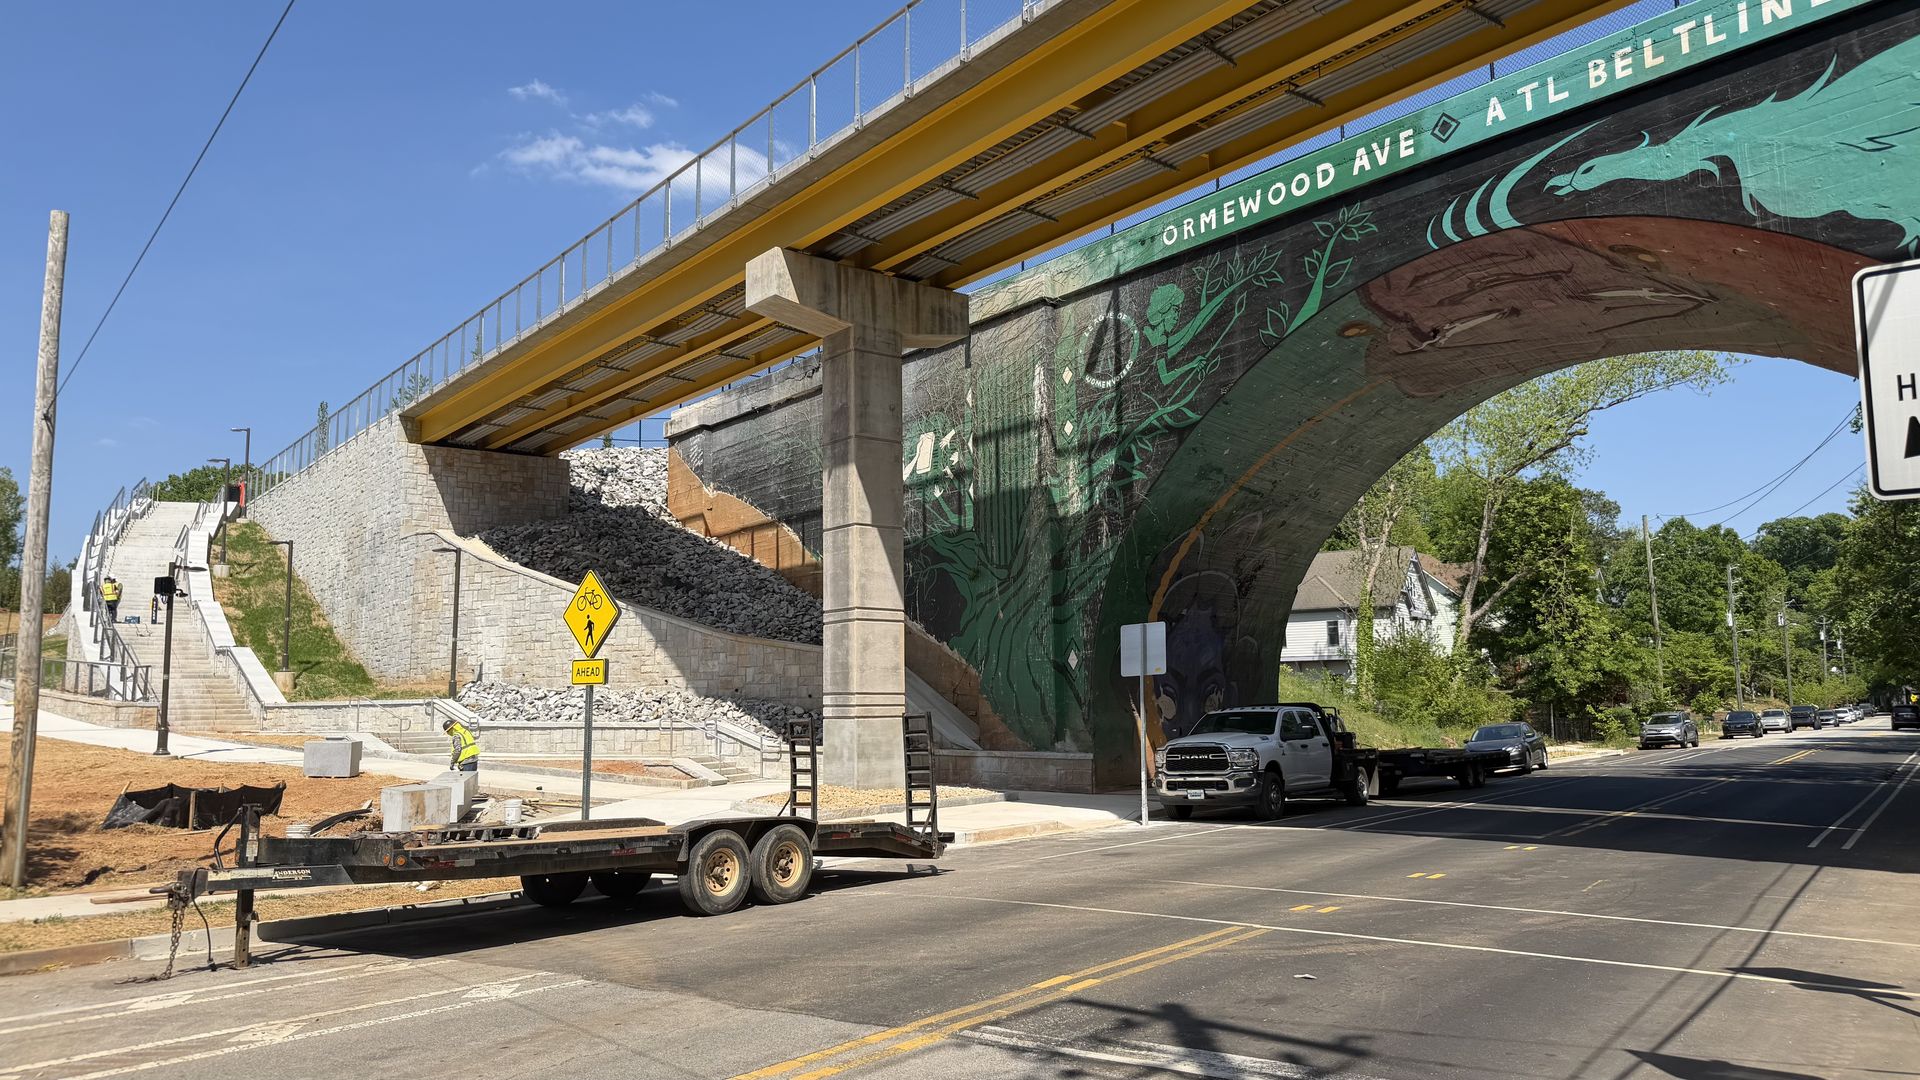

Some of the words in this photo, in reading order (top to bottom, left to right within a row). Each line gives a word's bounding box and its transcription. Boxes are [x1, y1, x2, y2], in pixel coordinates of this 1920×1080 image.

[1162, 162, 1335, 246] ORMEWOOD
[1353, 129, 1414, 175] AVE
[1486, 76, 1569, 126] ATL
[1588, 0, 1832, 89] BELTLIN
[1085, 375, 1112, 389] WOMEN
[576, 666, 600, 676] AHEAD
[272, 868, 311, 879] ANDERSON
